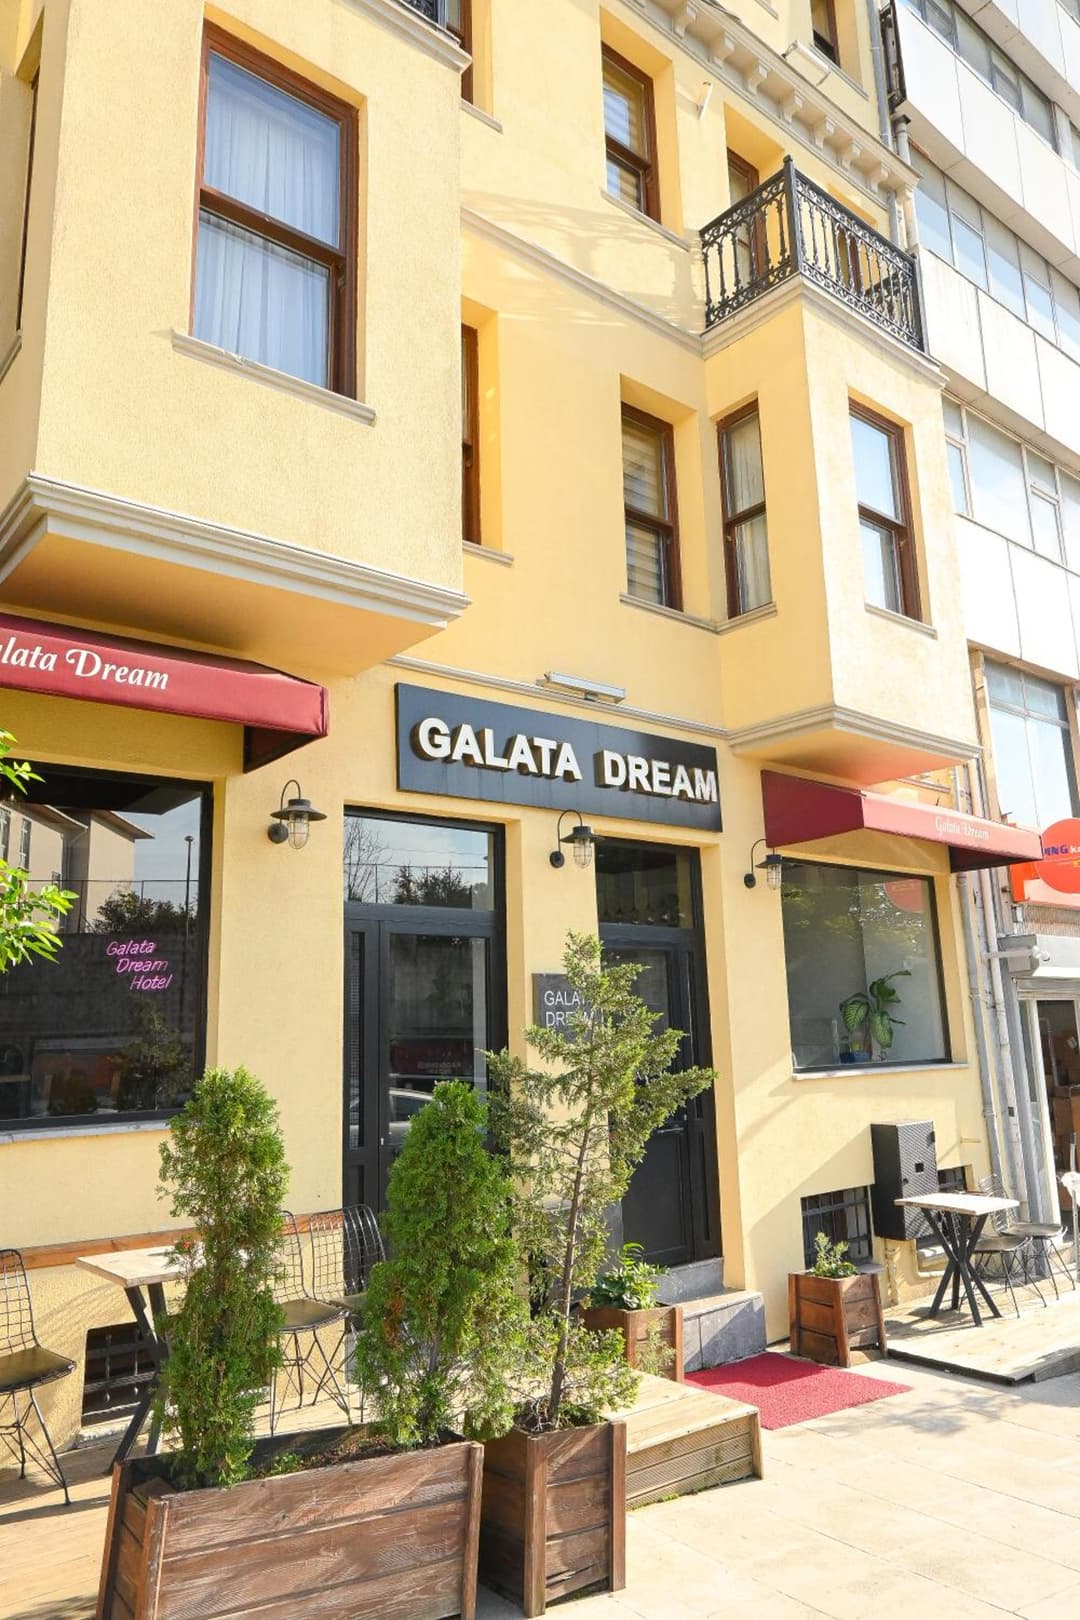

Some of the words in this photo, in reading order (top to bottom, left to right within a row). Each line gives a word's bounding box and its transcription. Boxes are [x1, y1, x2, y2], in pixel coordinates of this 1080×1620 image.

[0, 637, 58, 671] lata
[65, 649, 169, 689] Dream
[416, 717, 583, 780] GALATA
[602, 750, 717, 802] DREAM
[106, 940, 155, 955] Galata
[116, 958, 168, 973] Dream
[130, 974, 173, 990] Hotel
